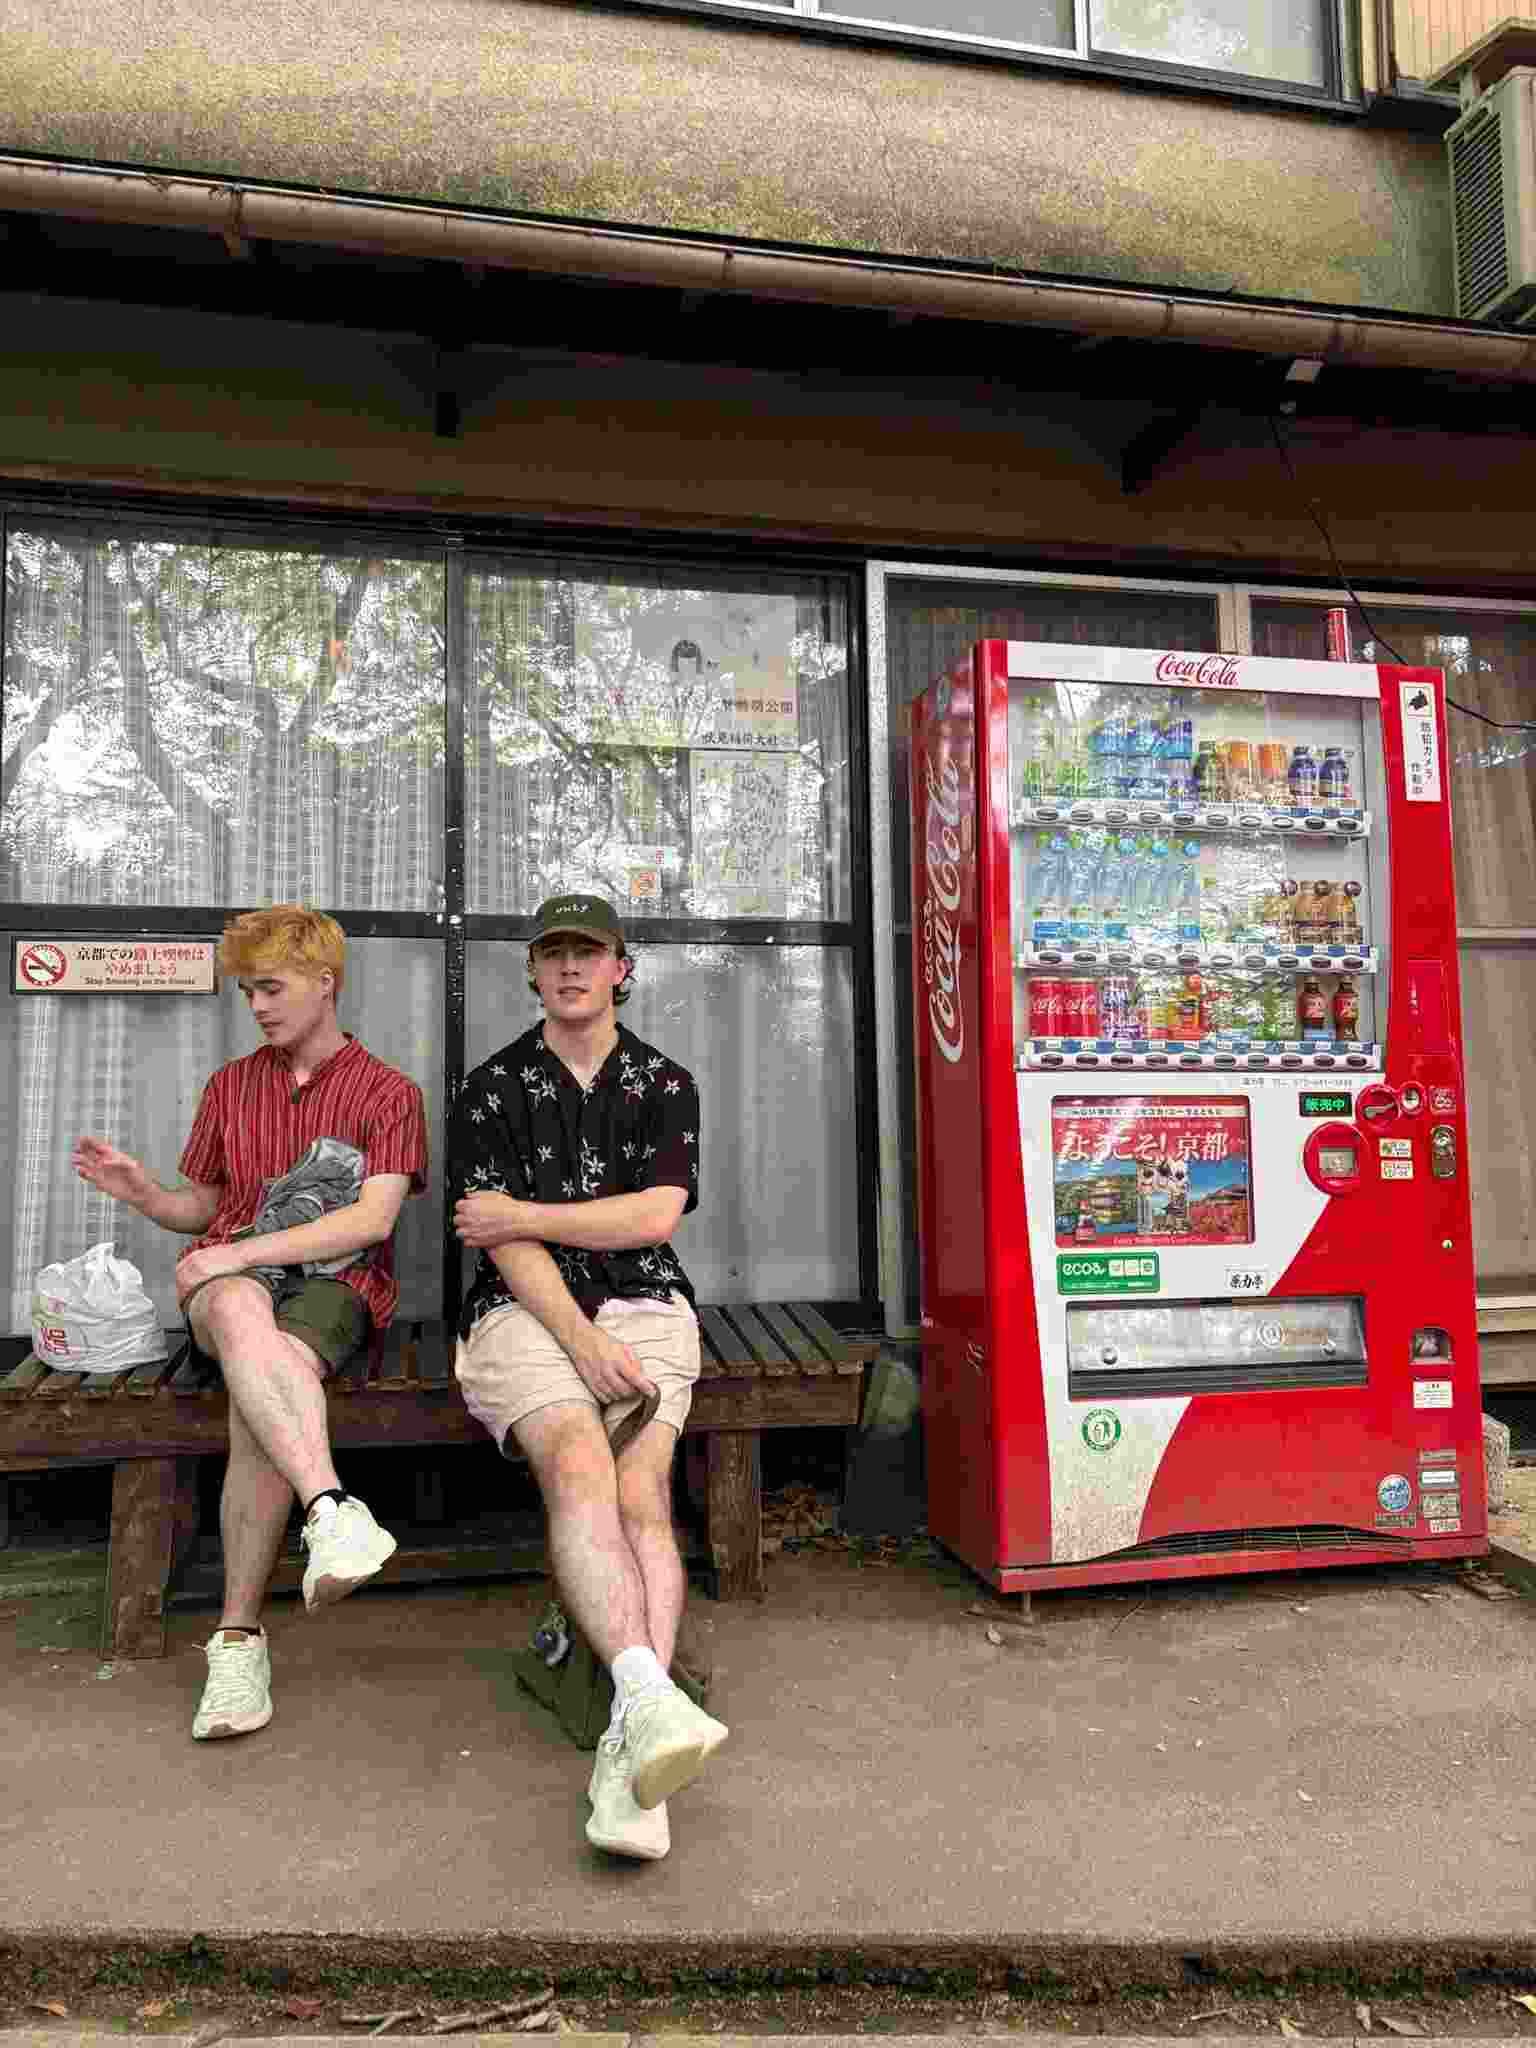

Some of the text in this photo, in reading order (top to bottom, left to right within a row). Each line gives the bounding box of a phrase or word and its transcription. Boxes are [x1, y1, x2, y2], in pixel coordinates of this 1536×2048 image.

[1156, 653, 1241, 686] Coca-Cola
[1304, 1098, 1345, 1112] 販売中
